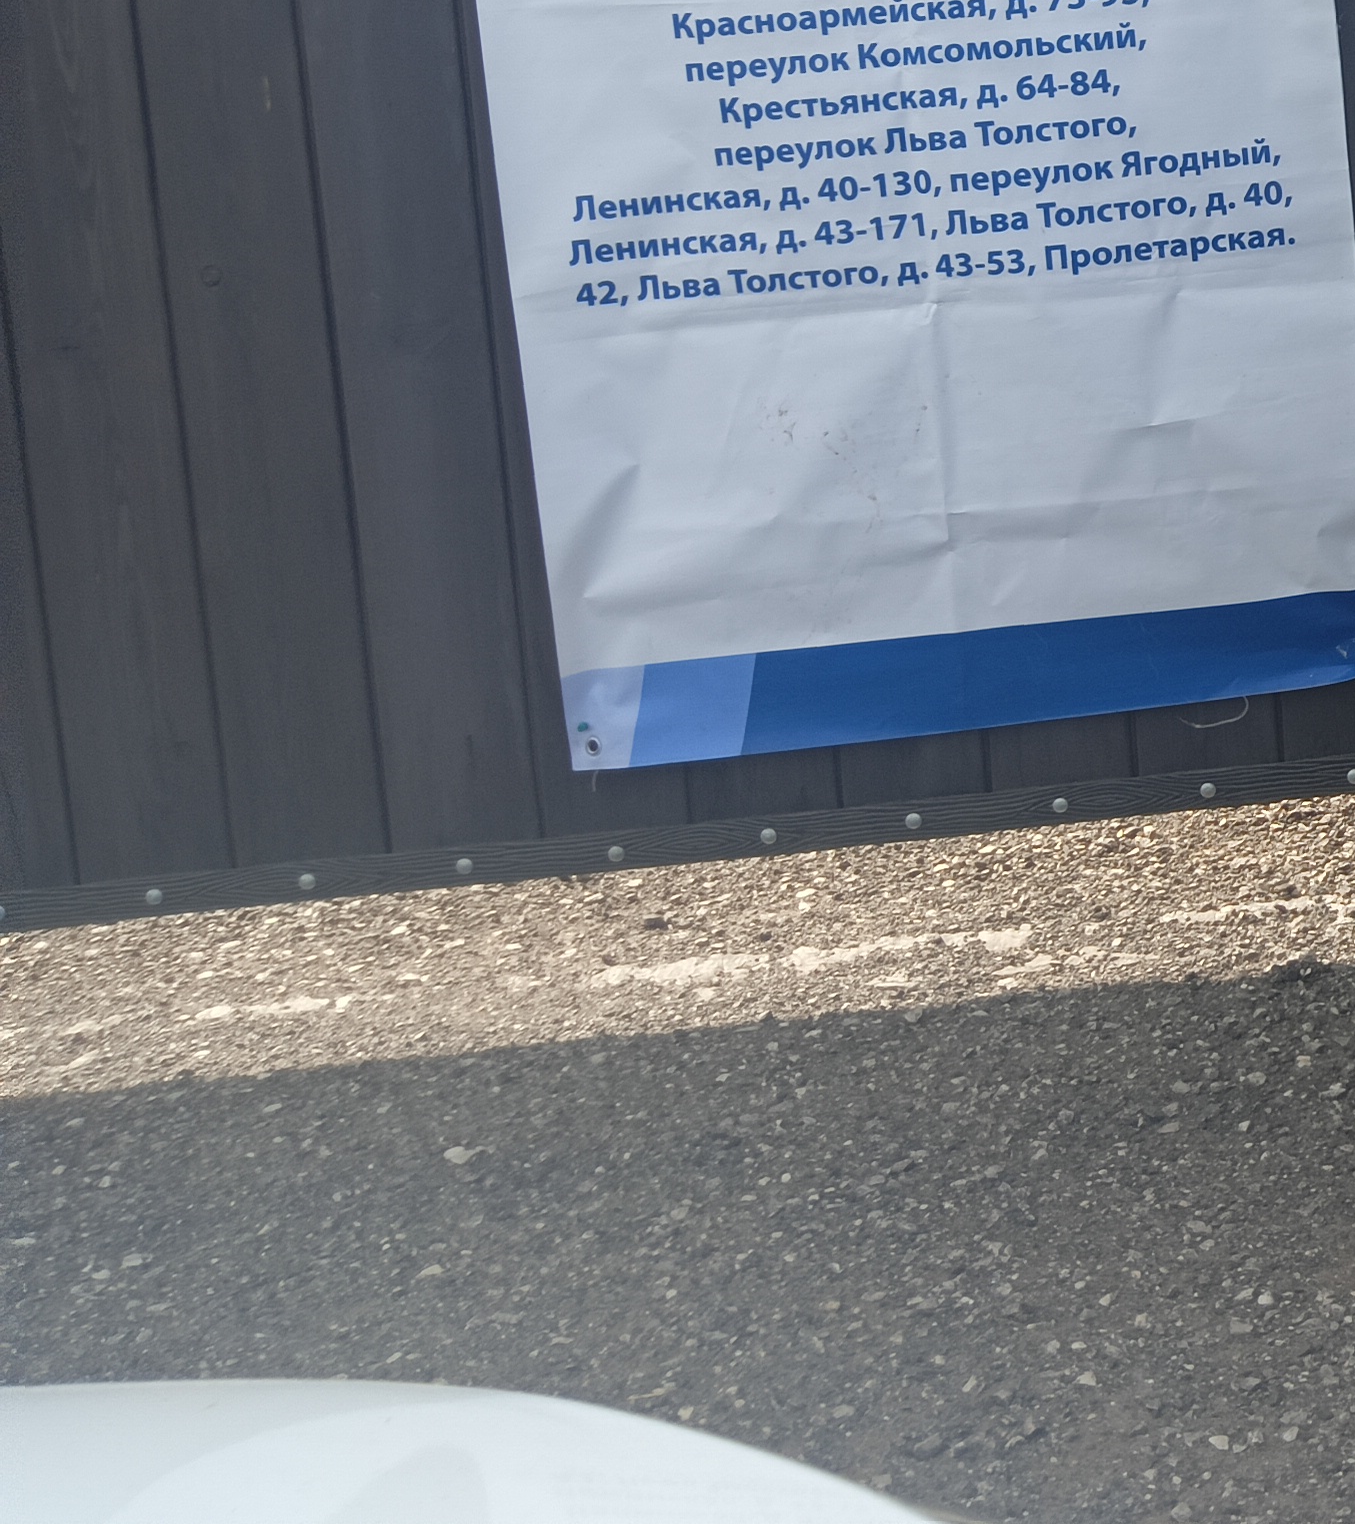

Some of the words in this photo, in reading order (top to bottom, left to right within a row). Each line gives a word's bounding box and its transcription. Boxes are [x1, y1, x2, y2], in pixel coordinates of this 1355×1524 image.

[684, 51, 851, 88] переулок
[857, 21, 1147, 70] Комсомольский,
[718, 86, 968, 130] Крестьянская,
[976, 83, 1009, 110] д.
[1015, 68, 1121, 101] 64-84,
[572, 188, 772, 223] Ленинская,
[778, 186, 811, 212] д.
[817, 169, 942, 203] 40-130,
[949, 160, 1114, 197] переулок
[1120, 137, 1281, 178] Ягодный,
[713, 136, 878, 172] переулок
[883, 126, 968, 155] Льва
[973, 116, 1137, 147] Толстого,
[568, 231, 768, 267] Ленинская,
[775, 229, 808, 255] д.
[813, 212, 938, 246] 43-171,
[945, 209, 1029, 237] Льва
[1035, 195, 1197, 229] Толстого,
[1205, 191, 1236, 218] д.
[1243, 180, 1293, 209] 40,
[575, 279, 629, 308] 42,
[636, 274, 722, 302] Льва
[726, 265, 889, 295] Толстого,
[896, 261, 929, 287] д.
[935, 248, 1037, 278] 43-53,
[1044, 227, 1296, 276] Пролетарская.
